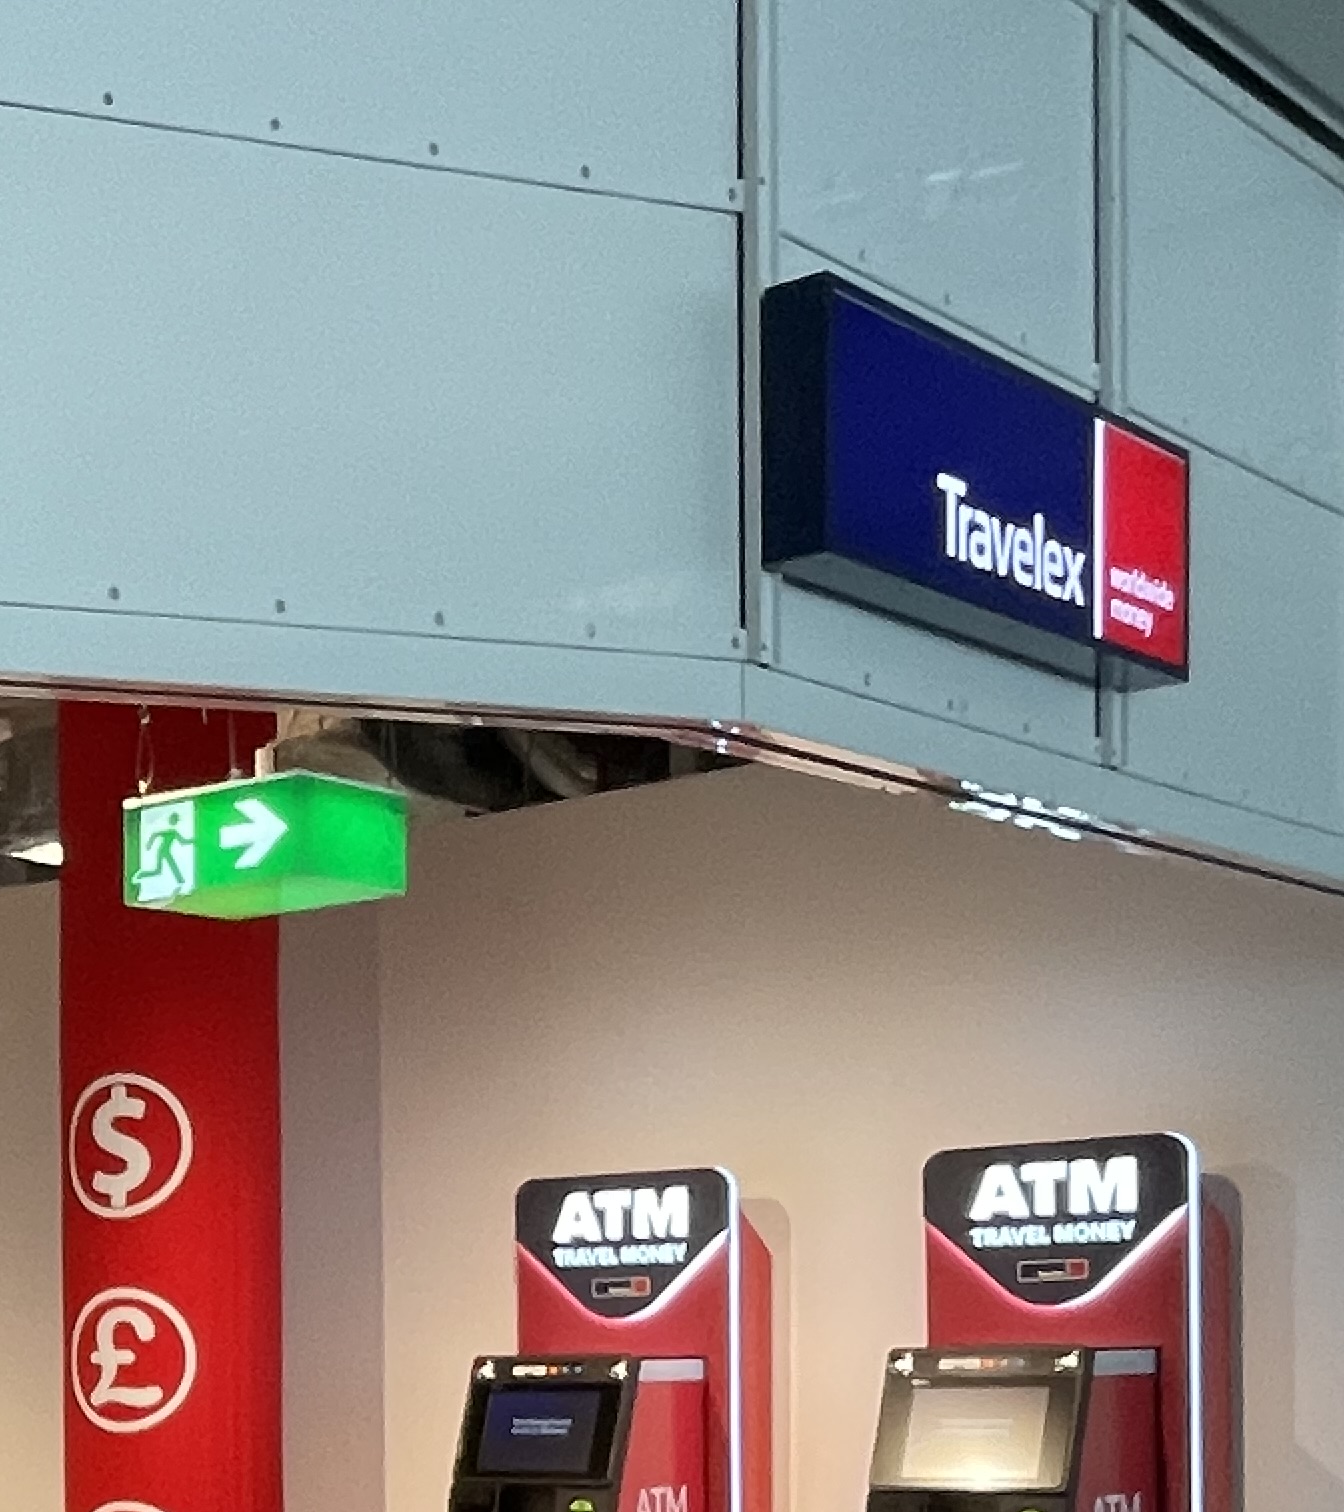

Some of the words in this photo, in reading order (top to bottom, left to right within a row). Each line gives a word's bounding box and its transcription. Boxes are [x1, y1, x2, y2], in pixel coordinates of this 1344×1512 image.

[936, 473, 1086, 607] Travelex
[92, 1082, 152, 1210] $
[552, 1185, 690, 1243] ATM
[968, 1156, 1138, 1221] ATM
[552, 1247, 618, 1268] TRAVEL
[620, 1242, 688, 1265] MONEY
[969, 1225, 1052, 1248] TRAVEL
[1053, 1220, 1137, 1243] MONEY
[91, 1306, 163, 1407] £
